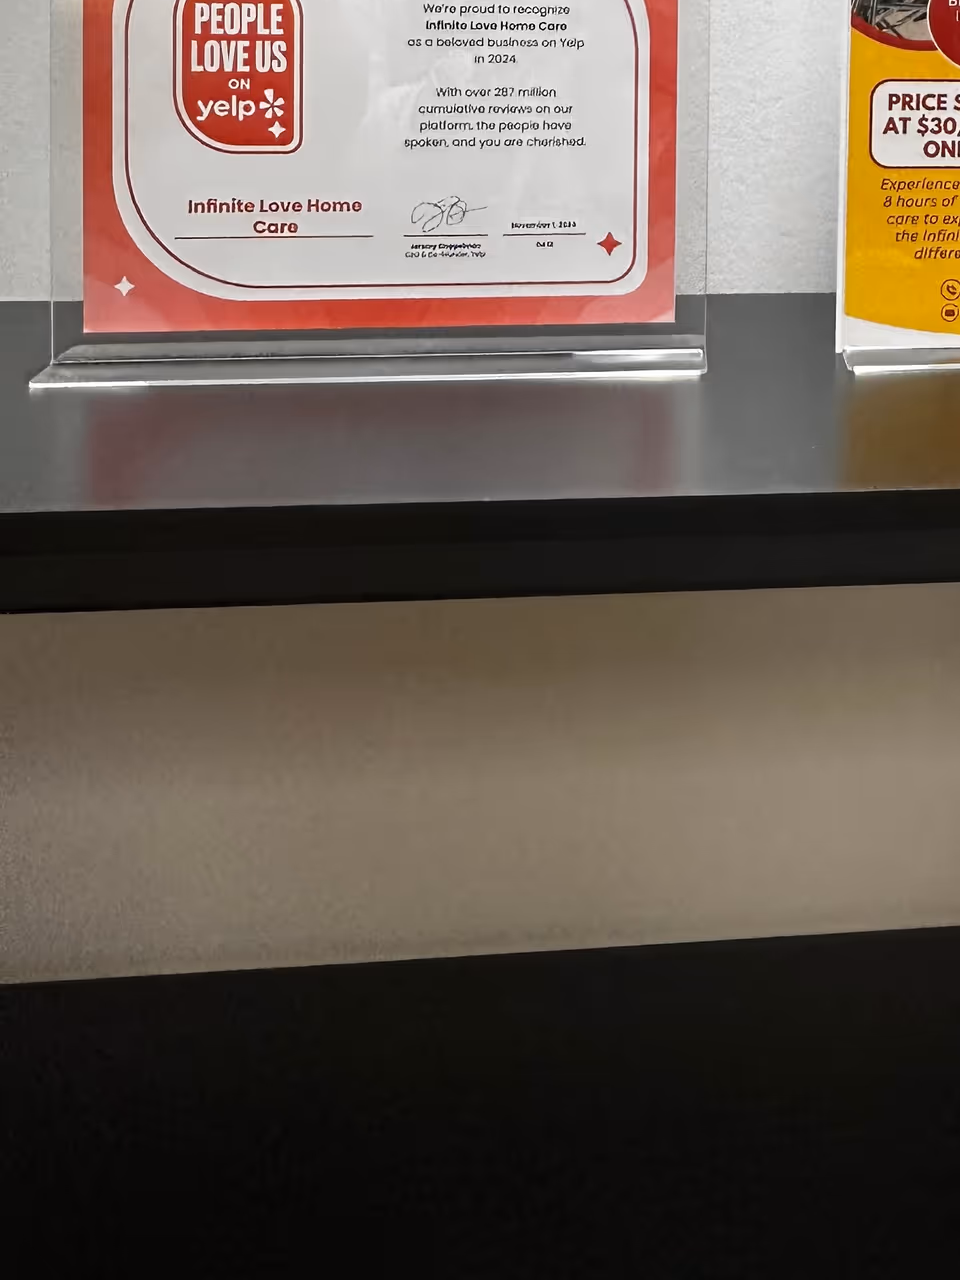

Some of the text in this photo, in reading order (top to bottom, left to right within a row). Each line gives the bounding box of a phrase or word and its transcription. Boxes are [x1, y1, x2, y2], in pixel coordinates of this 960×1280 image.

[423, 4, 570, 17] We're proud to recognize
[194, 3, 284, 35] PEOPLE
[425, 20, 567, 31] Infinite Love Home Care
[407, 39, 422, 47] as
[437, 37, 484, 47] beloved
[488, 37, 538, 47] business
[560, 38, 585, 50] Yelp
[191, 40, 287, 73] LOVE US
[474, 55, 484, 64] in
[228, 79, 250, 90] ON
[436, 87, 557, 97] With over 287 million
[196, 95, 256, 121] yelp
[888, 93, 948, 111] PRICE
[418, 104, 573, 114] cumulative reviews on our
[477, 121, 495, 130] the
[499, 122, 539, 133] people
[543, 121, 572, 130] have
[883, 117, 911, 134] AT
[452, 138, 476, 147] and
[479, 139, 500, 149] you
[504, 139, 523, 147] are
[881, 178, 960, 192] Experience
[188, 198, 363, 213] Infinite Love Home
[883, 196, 892, 208] 8
[897, 195, 937, 207] hours
[942, 195, 958, 207] of
[887, 214, 919, 225] care
[924, 214, 938, 225] to
[253, 220, 298, 234] Care
[896, 230, 918, 242] the
